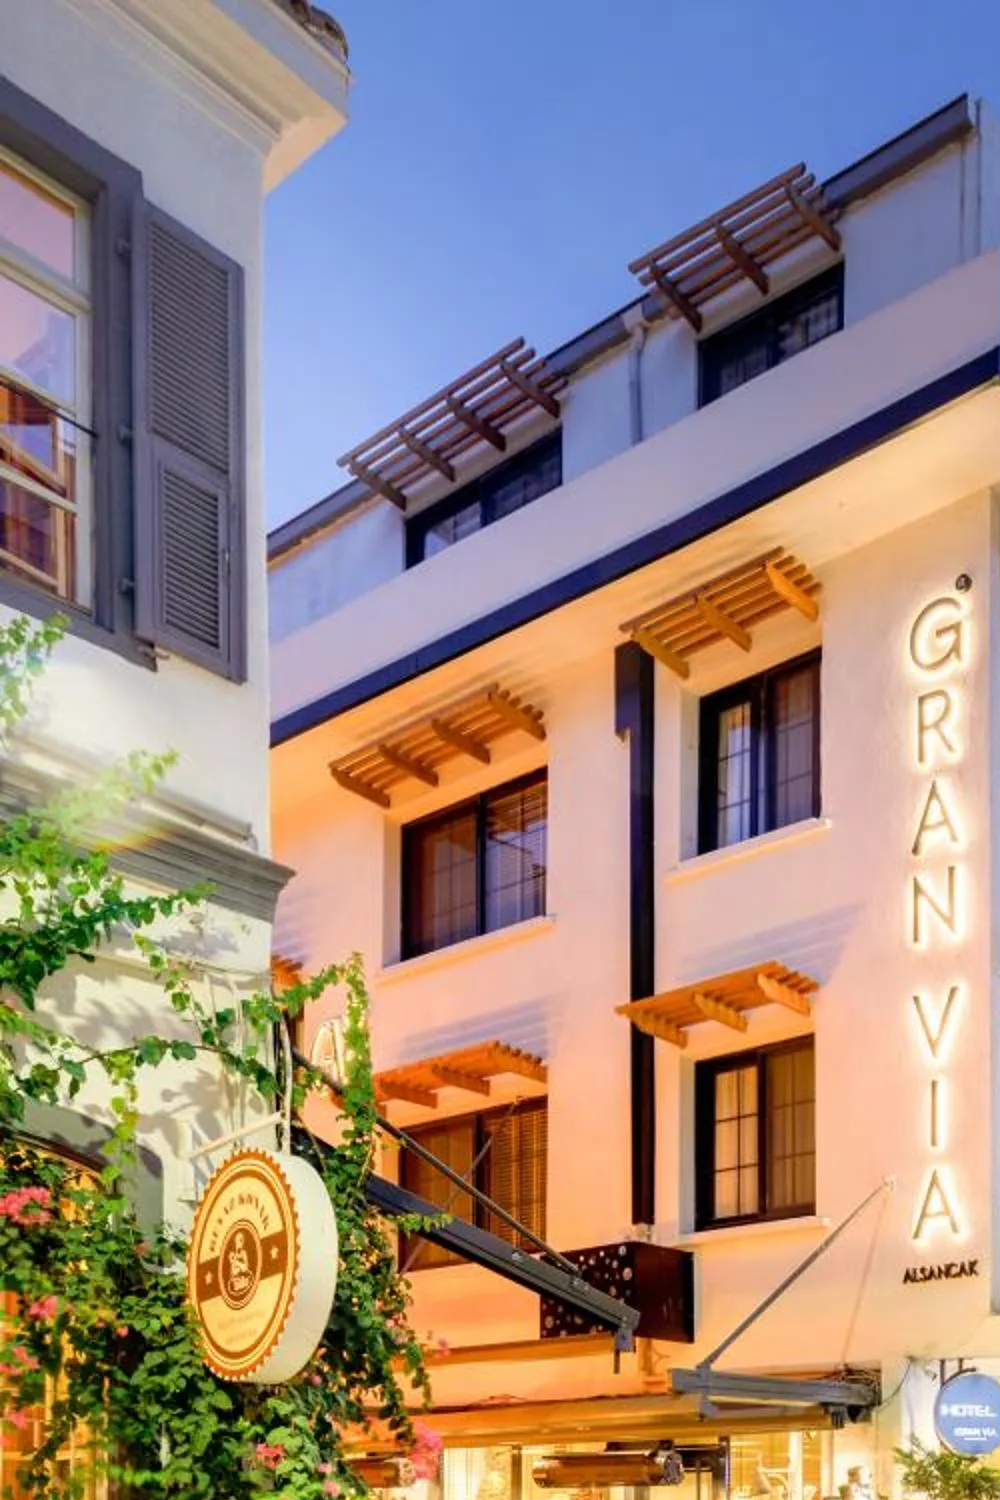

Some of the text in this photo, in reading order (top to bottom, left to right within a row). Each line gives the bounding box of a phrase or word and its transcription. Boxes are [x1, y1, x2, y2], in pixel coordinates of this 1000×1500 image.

[909, 597, 962, 1241] GRAN VIA
[902, 1259, 979, 1284] ALSANCAK
[940, 1404, 998, 1418] HOTEL
